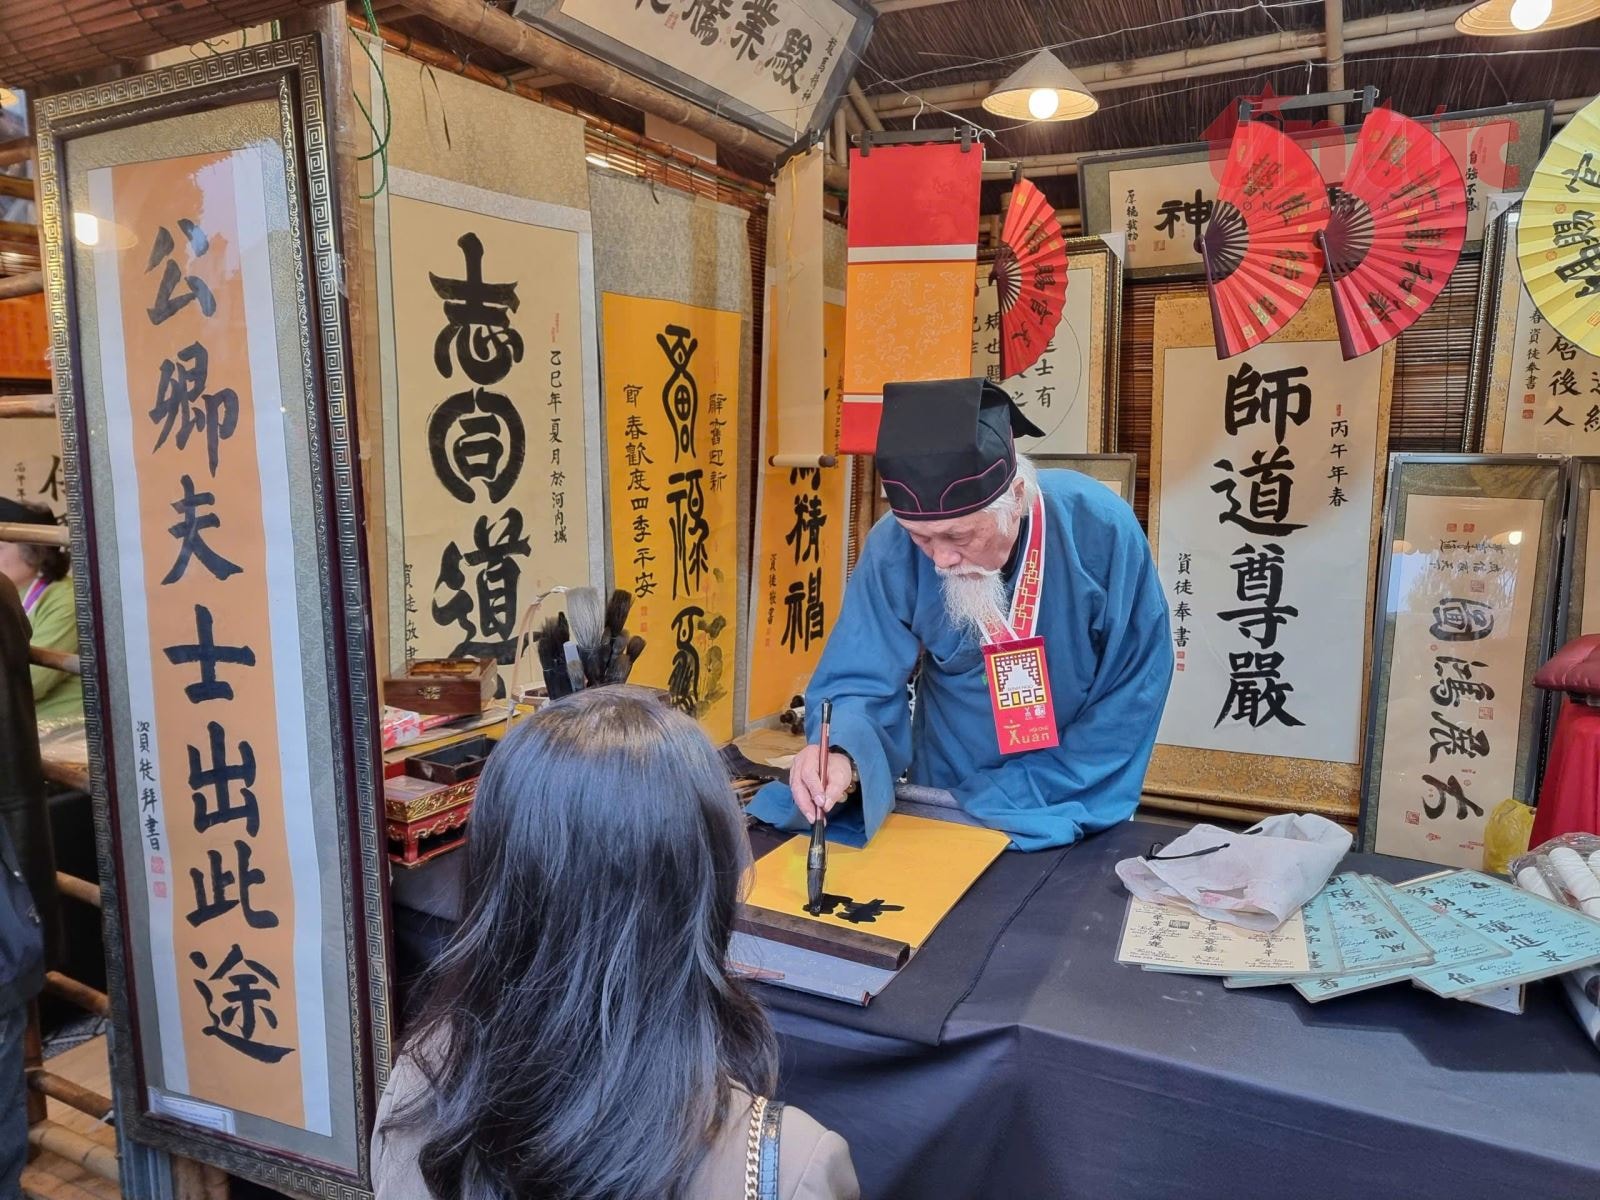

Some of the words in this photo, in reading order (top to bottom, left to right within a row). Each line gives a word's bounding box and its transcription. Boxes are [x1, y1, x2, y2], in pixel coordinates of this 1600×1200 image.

[428, 231, 532, 700] 志同道
[1210, 362, 1312, 729] 師道尊嚴
[1326, 419, 1350, 508] 丙午年春
[145, 217, 296, 1065] 公卿夫士出此途
[998, 687, 1045, 708] 2026
[1172, 552, 1193, 648] 資徒奉書
